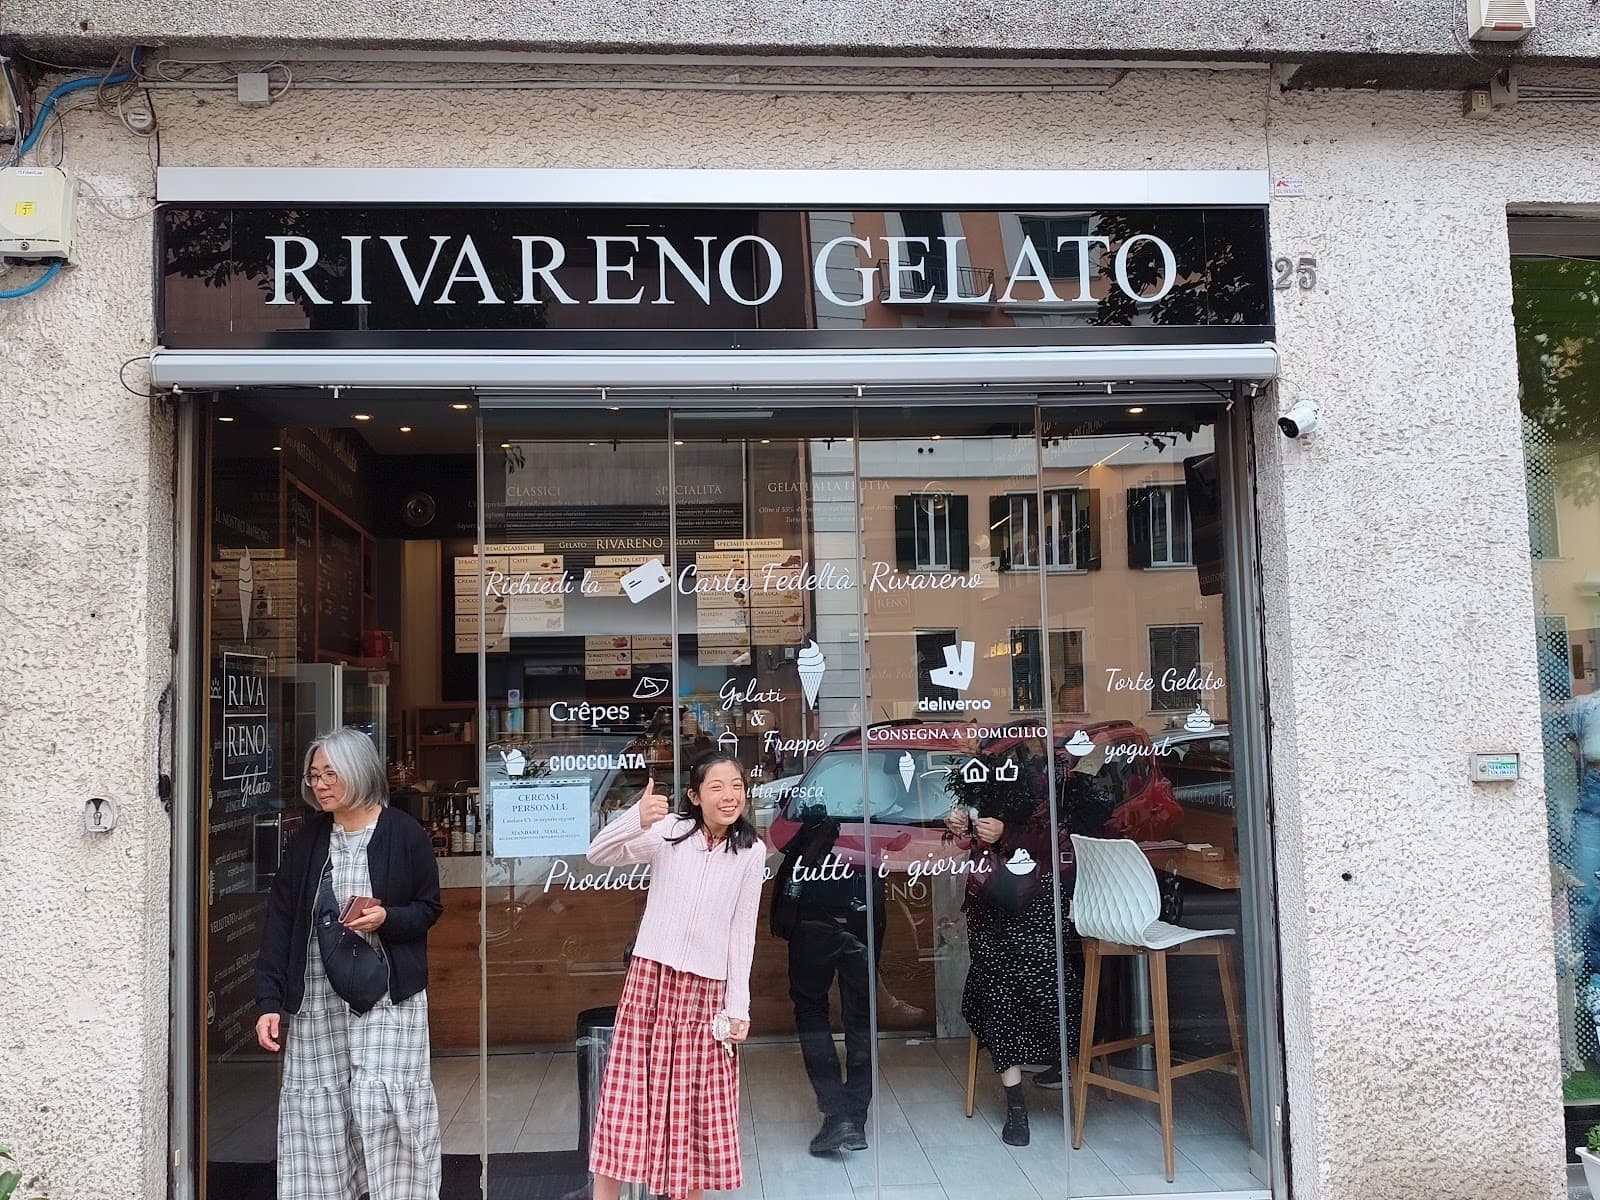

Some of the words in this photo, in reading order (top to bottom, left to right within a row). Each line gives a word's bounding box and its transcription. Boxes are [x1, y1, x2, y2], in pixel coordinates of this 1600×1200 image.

[265, 234, 783, 306] RIVARENO
[814, 235, 1178, 307] GELATO
[1275, 256, 1317, 291] 25
[506, 486, 561, 497] CLASSICI
[559, 541, 587, 550] GELATO
[596, 537, 664, 550] RIVARENO
[485, 570, 574, 597] Richiedi
[580, 569, 602, 594] la
[677, 564, 753, 595] Carta
[761, 560, 854, 594] Fedeltà
[869, 561, 984, 593] Rivareno
[227, 675, 266, 706] RIVA
[1105, 667, 1156, 693] Torte
[1161, 667, 1226, 693] Gelato
[719, 677, 787, 712] Gelati
[918, 696, 992, 711] deliveroo
[549, 701, 631, 728] Crêpes
[750, 709, 766, 727] &
[227, 724, 267, 758] RENO
[763, 730, 828, 760] Frappé
[866, 728, 949, 741] CONSEGNA
[951, 728, 963, 740] A
[966, 726, 1049, 740] DOMICILIO
[549, 752, 647, 772] CIOCCOLATA
[1104, 736, 1174, 764] yogurt
[750, 765, 764, 779] di
[240, 765, 272, 808] Gelato
[518, 793, 560, 802] CERCASI
[774, 782, 825, 803] fresca
[511, 803, 568, 813] PERSONALE
[542, 859, 652, 893] Prodott
[792, 853, 856, 883] tutti
[878, 854, 890, 879] i
